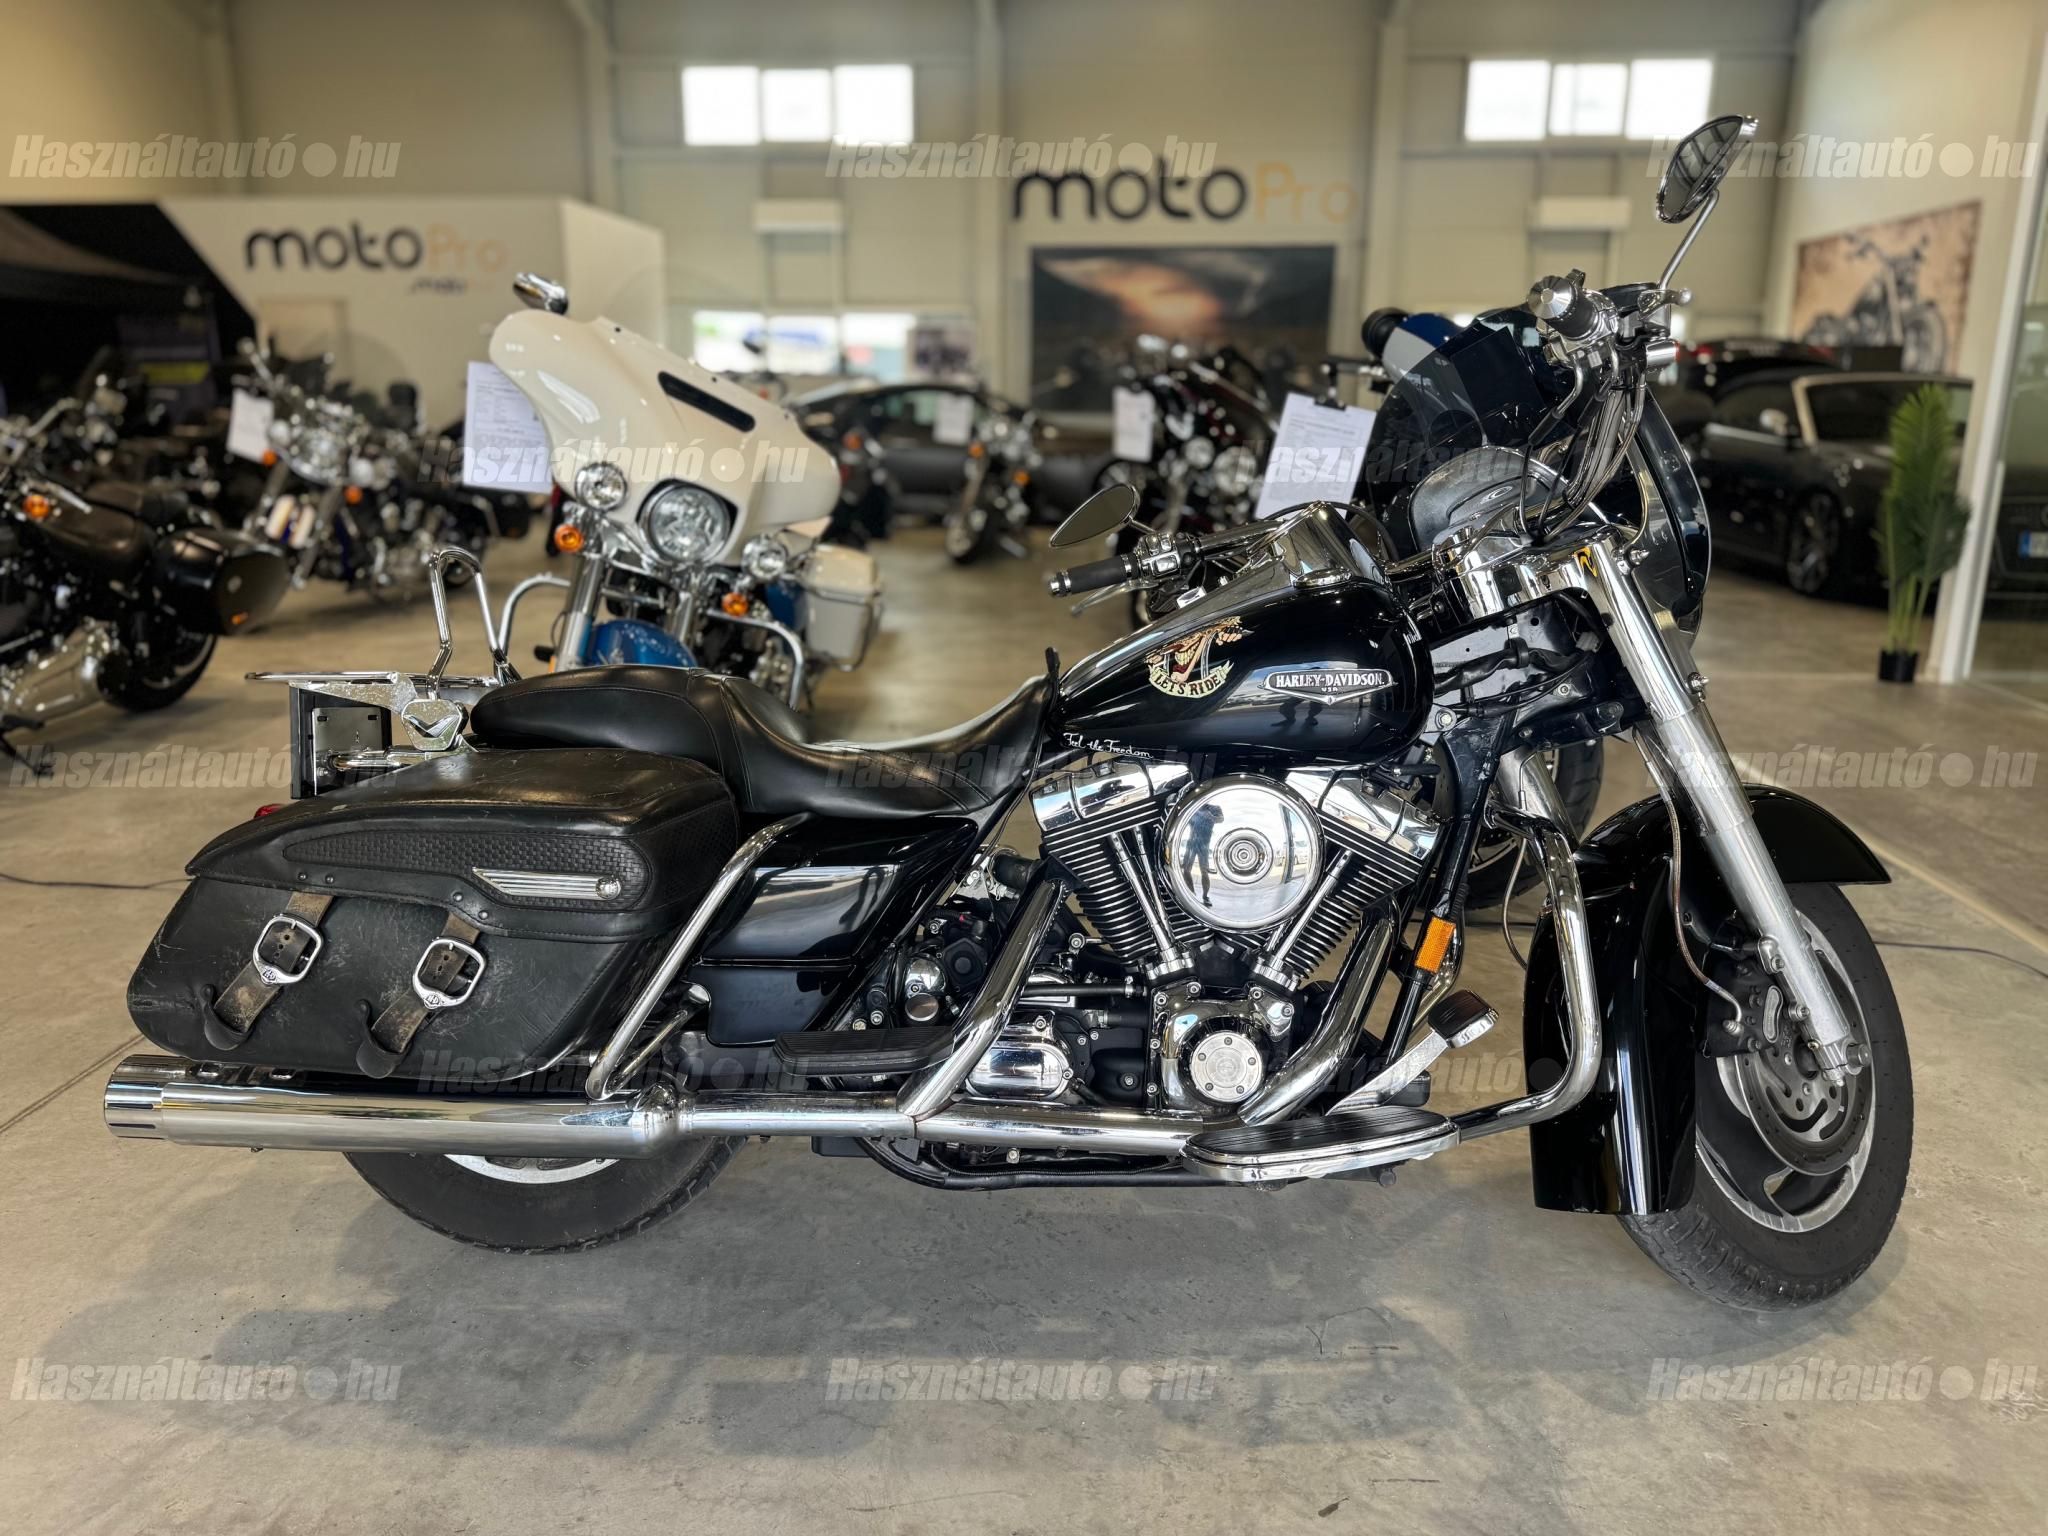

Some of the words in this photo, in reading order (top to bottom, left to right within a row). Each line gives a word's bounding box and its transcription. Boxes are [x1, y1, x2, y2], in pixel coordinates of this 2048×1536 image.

[1190, 675, 1221, 696] RIDE
[1063, 732, 1086, 749] Feel
[1087, 739, 1104, 752] the
[1104, 739, 1153, 760] Freedom
